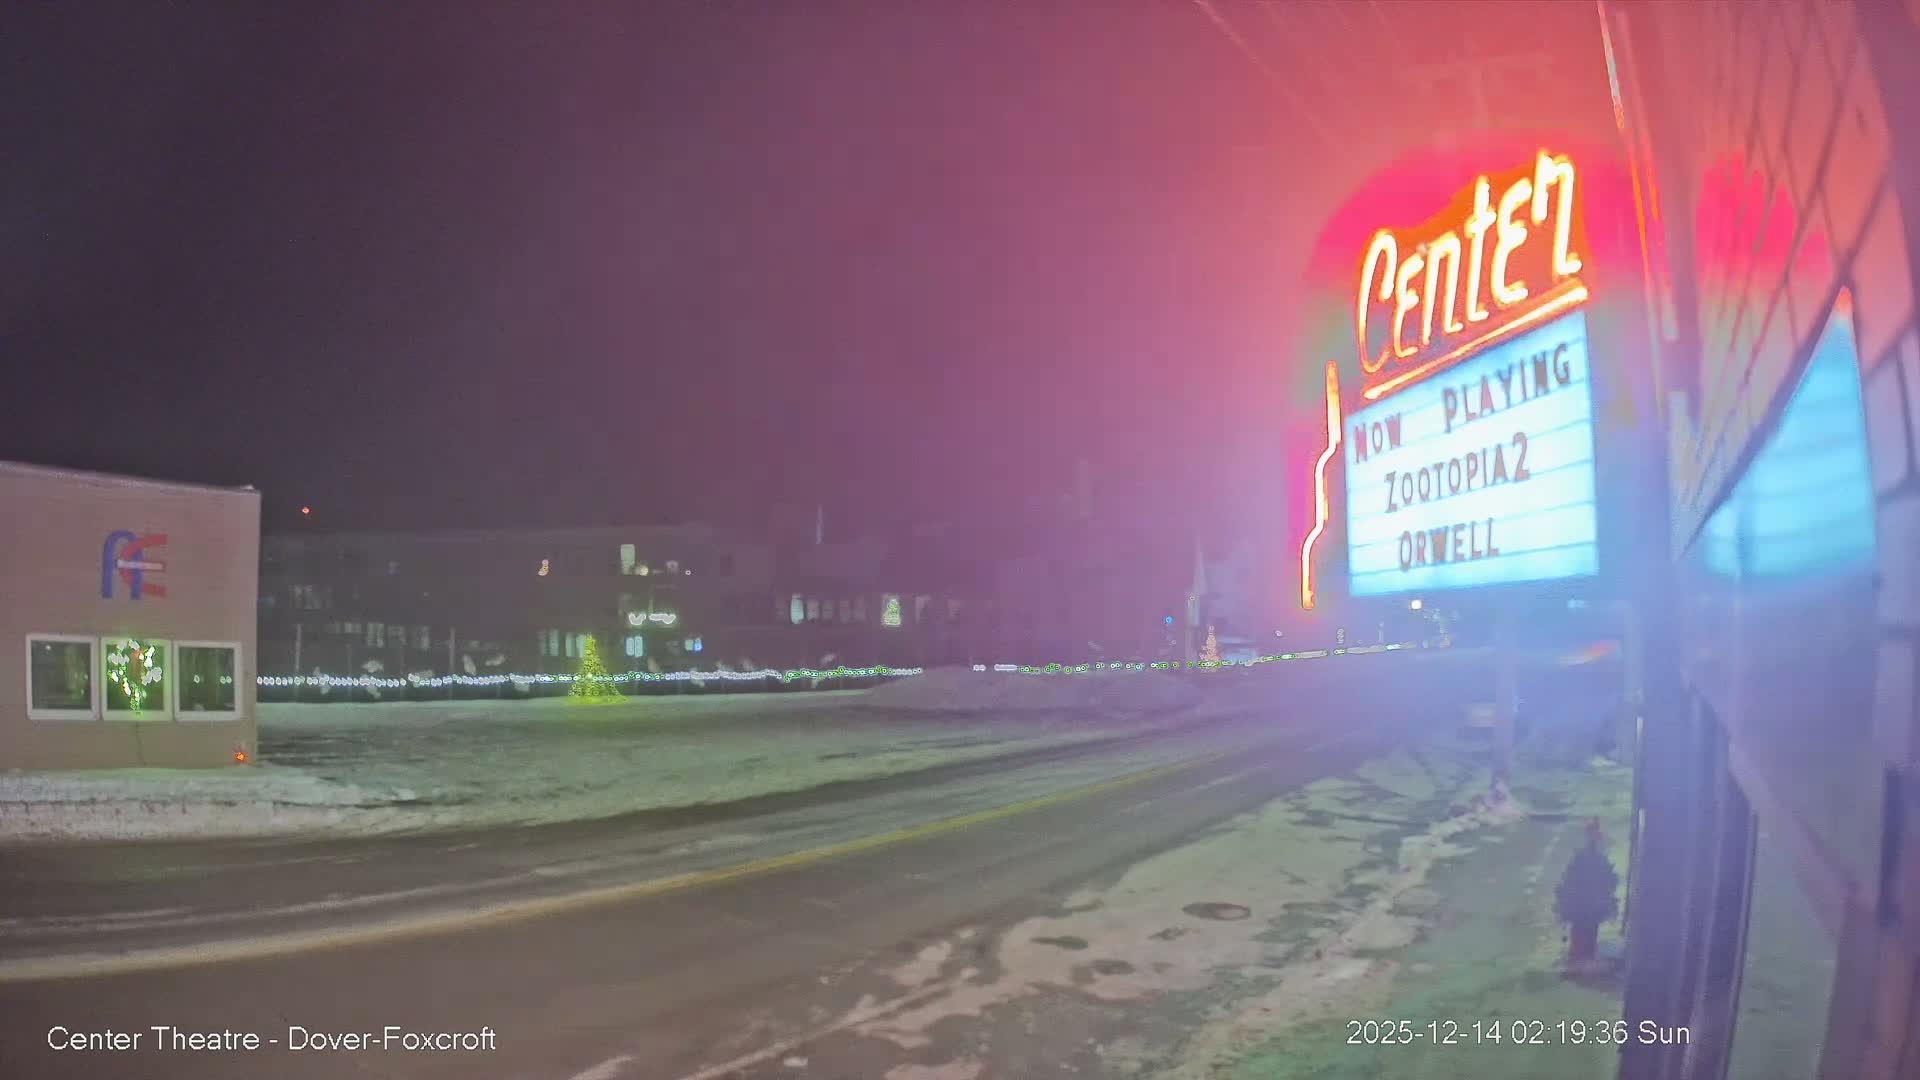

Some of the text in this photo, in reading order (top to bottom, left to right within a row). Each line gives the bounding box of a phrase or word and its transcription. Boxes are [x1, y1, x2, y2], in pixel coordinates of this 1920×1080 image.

[1354, 342, 1570, 464] NOW PLAYING
[1399, 518, 1500, 572] ORWELL
